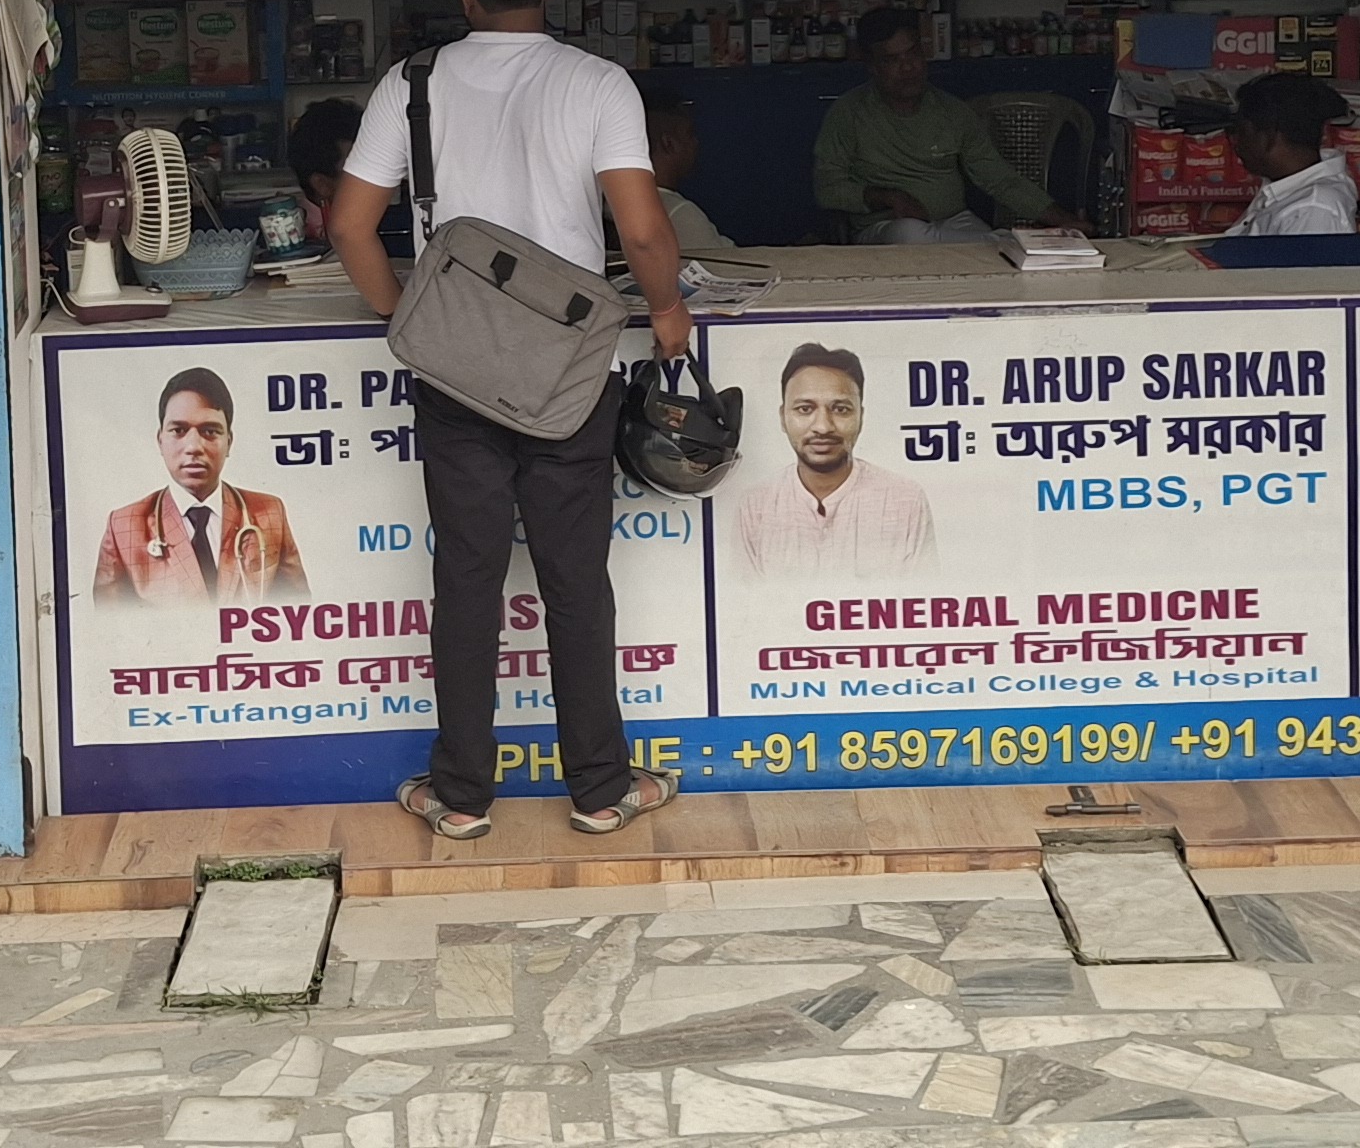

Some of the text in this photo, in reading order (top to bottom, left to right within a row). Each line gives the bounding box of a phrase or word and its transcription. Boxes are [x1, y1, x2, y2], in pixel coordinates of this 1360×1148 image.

[266, 372, 343, 413] DR.
[907, 350, 1327, 408] DR. ARUP SARKAR
[1163, 410, 1327, 460] সরকার
[1035, 471, 1328, 514] MBBS, PGT
[358, 523, 413, 553] MD
[805, 588, 1260, 631] GENERAL MEDICNE
[109, 654, 324, 696] মানসিক
[757, 639, 999, 676] জেনারেল
[749, 665, 1319, 701] MJN Medical College & Hospital
[127, 697, 370, 728] Ex-Tufanganj
[732, 732, 818, 773] +91
[1170, 717, 1258, 762] +91
